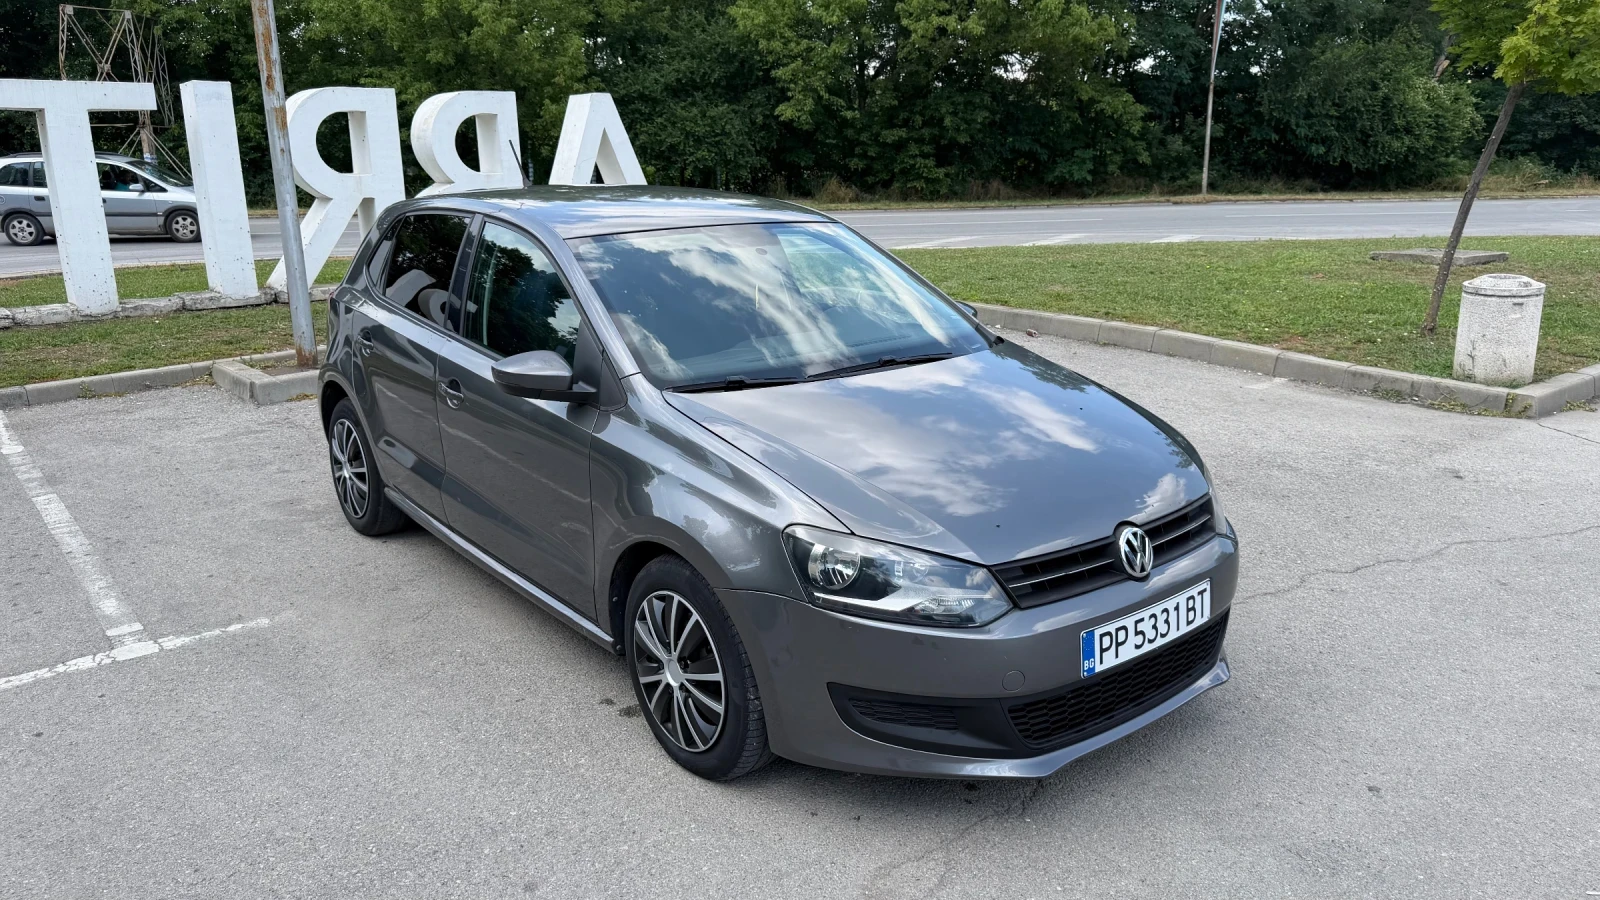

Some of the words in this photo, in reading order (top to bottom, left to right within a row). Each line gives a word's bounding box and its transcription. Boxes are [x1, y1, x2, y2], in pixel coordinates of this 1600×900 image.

[1099, 625, 1129, 665] PP
[1134, 602, 1180, 650] 5331
[1186, 587, 1208, 627] BT
[1084, 658, 1095, 671] BG
